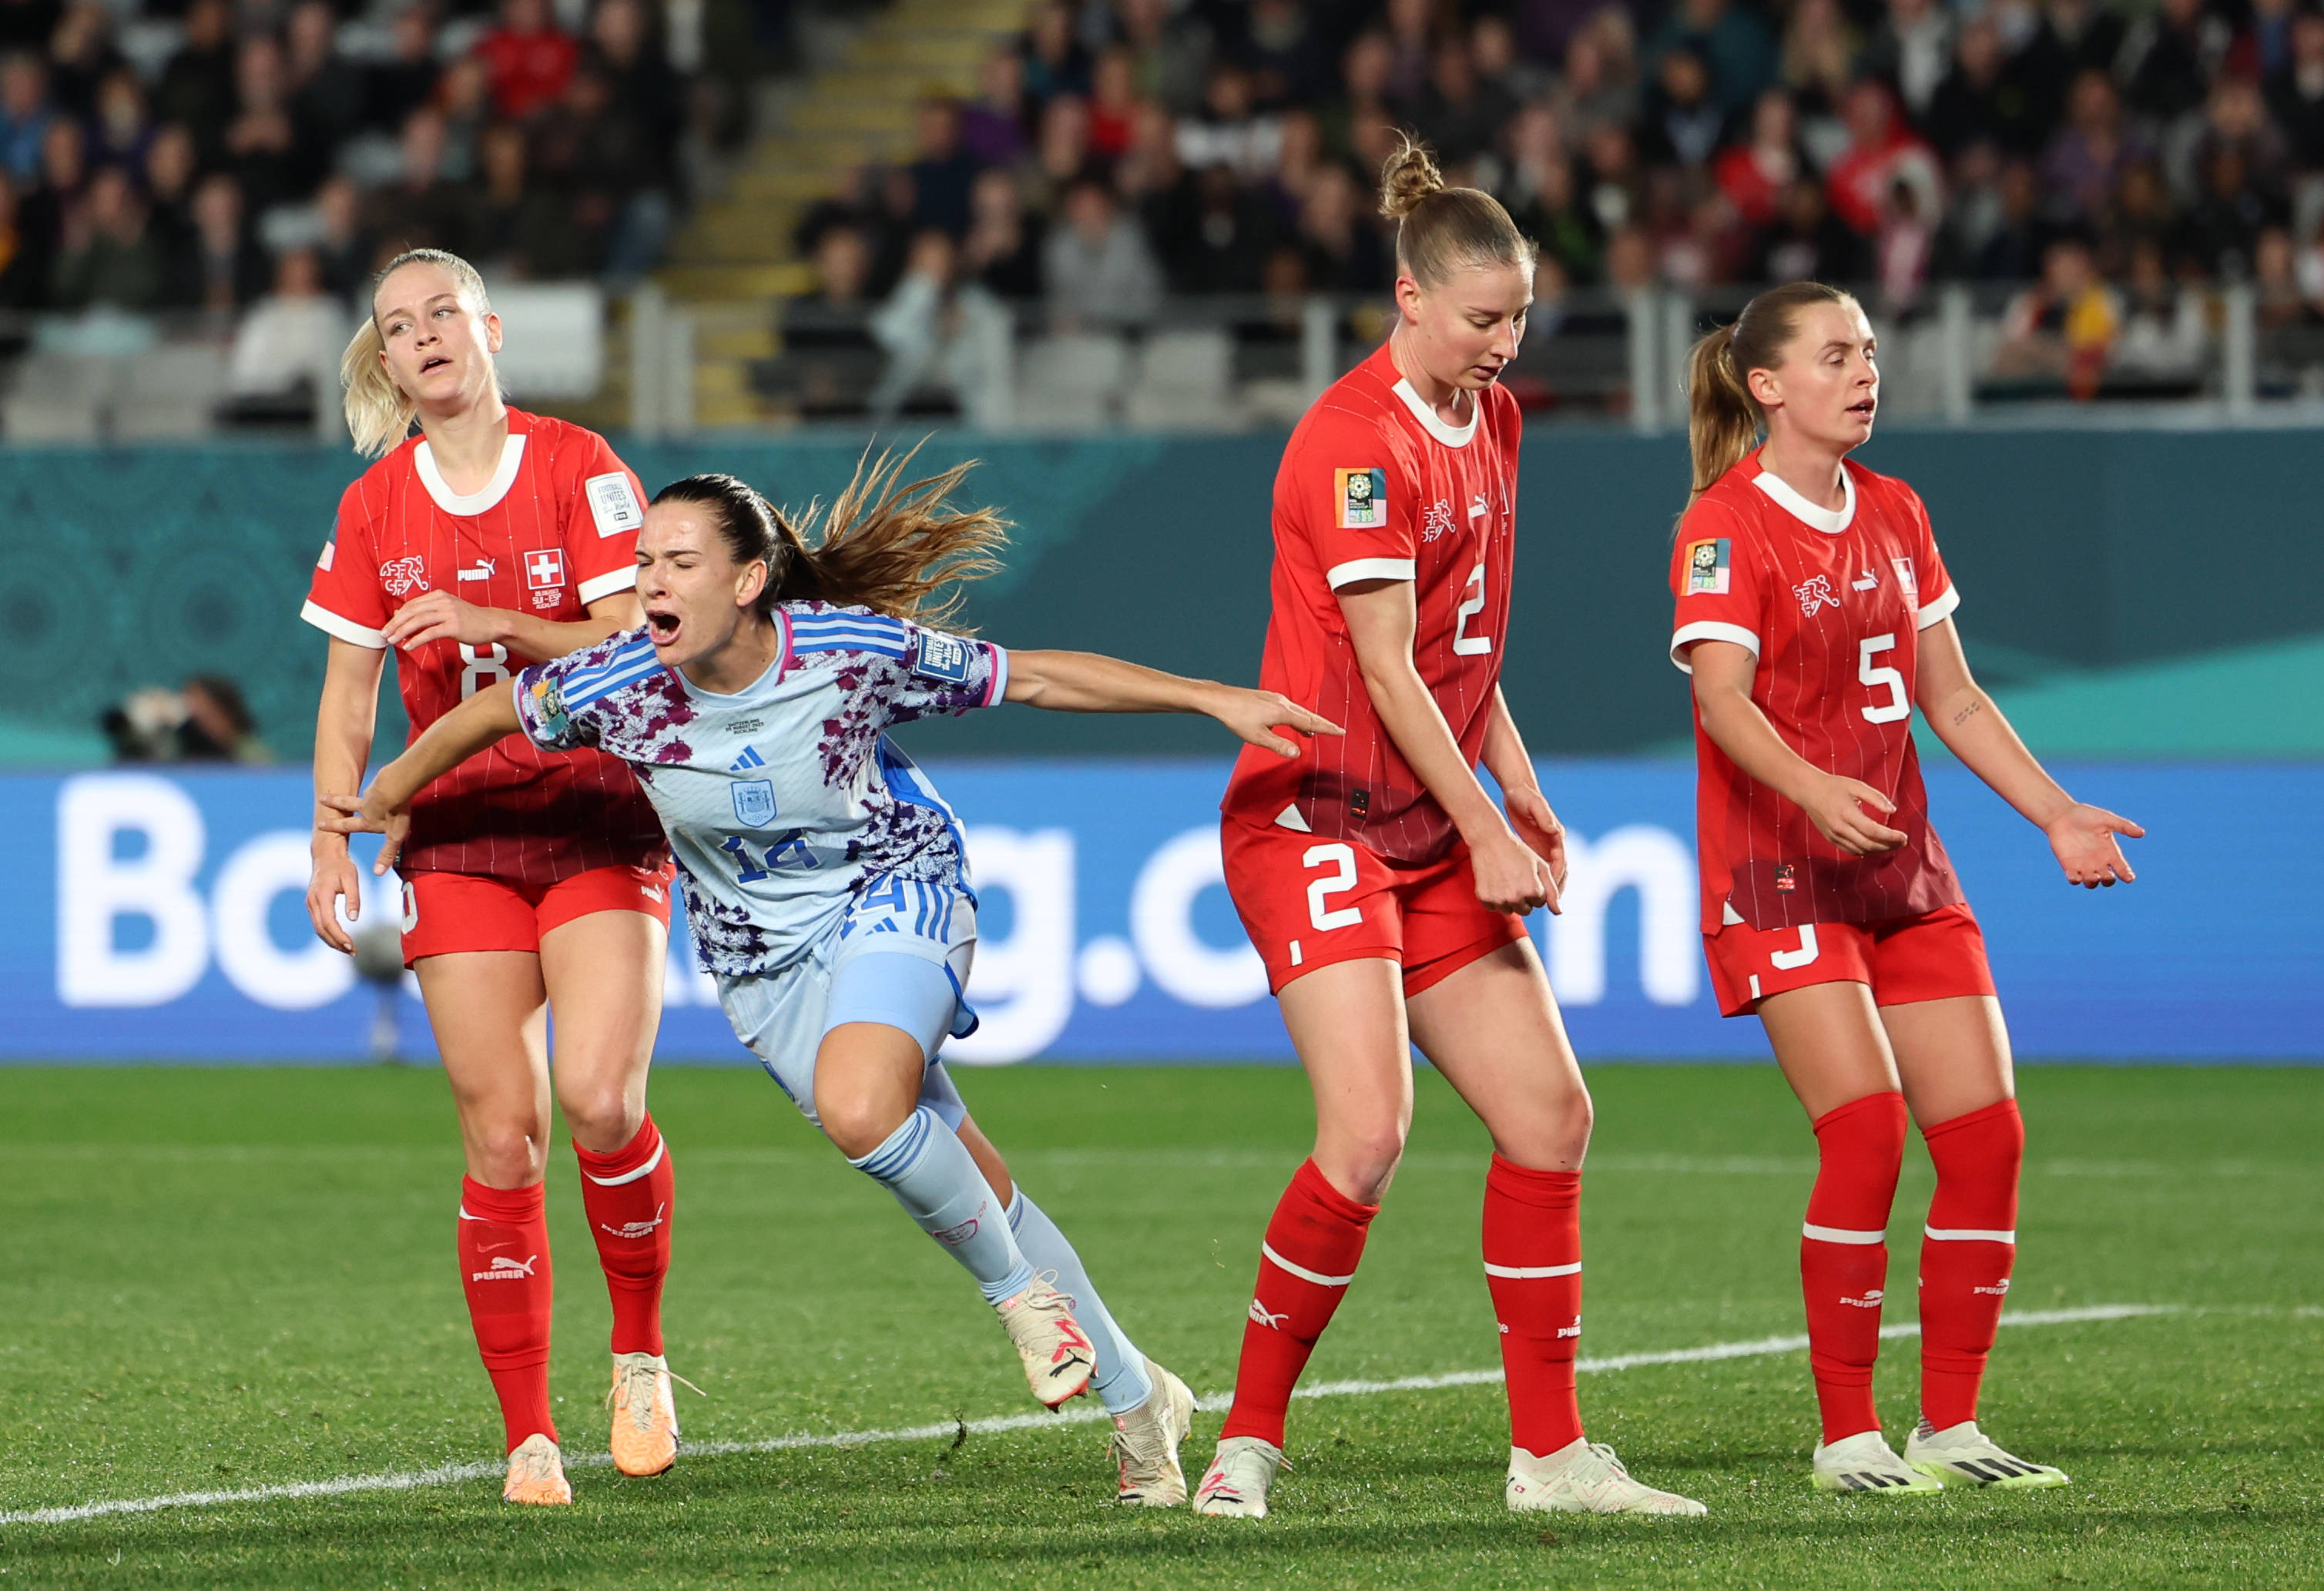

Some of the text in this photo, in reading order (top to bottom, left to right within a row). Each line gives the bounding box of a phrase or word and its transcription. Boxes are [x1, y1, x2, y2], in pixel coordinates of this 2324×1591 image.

[600, 490, 626, 504] UNITES
[458, 568, 489, 581] PUMA
[1453, 564, 1491, 655] 2
[459, 641, 510, 702] 8
[1859, 632, 1910, 725] 5
[717, 827, 820, 886] 14
[1303, 843, 1363, 931] 2
[602, 1223, 654, 1238] PUMA
[472, 1270, 525, 1282] PUMA
[1974, 1286, 2009, 1295] PUM
[1557, 1325, 1581, 1338] PUM
